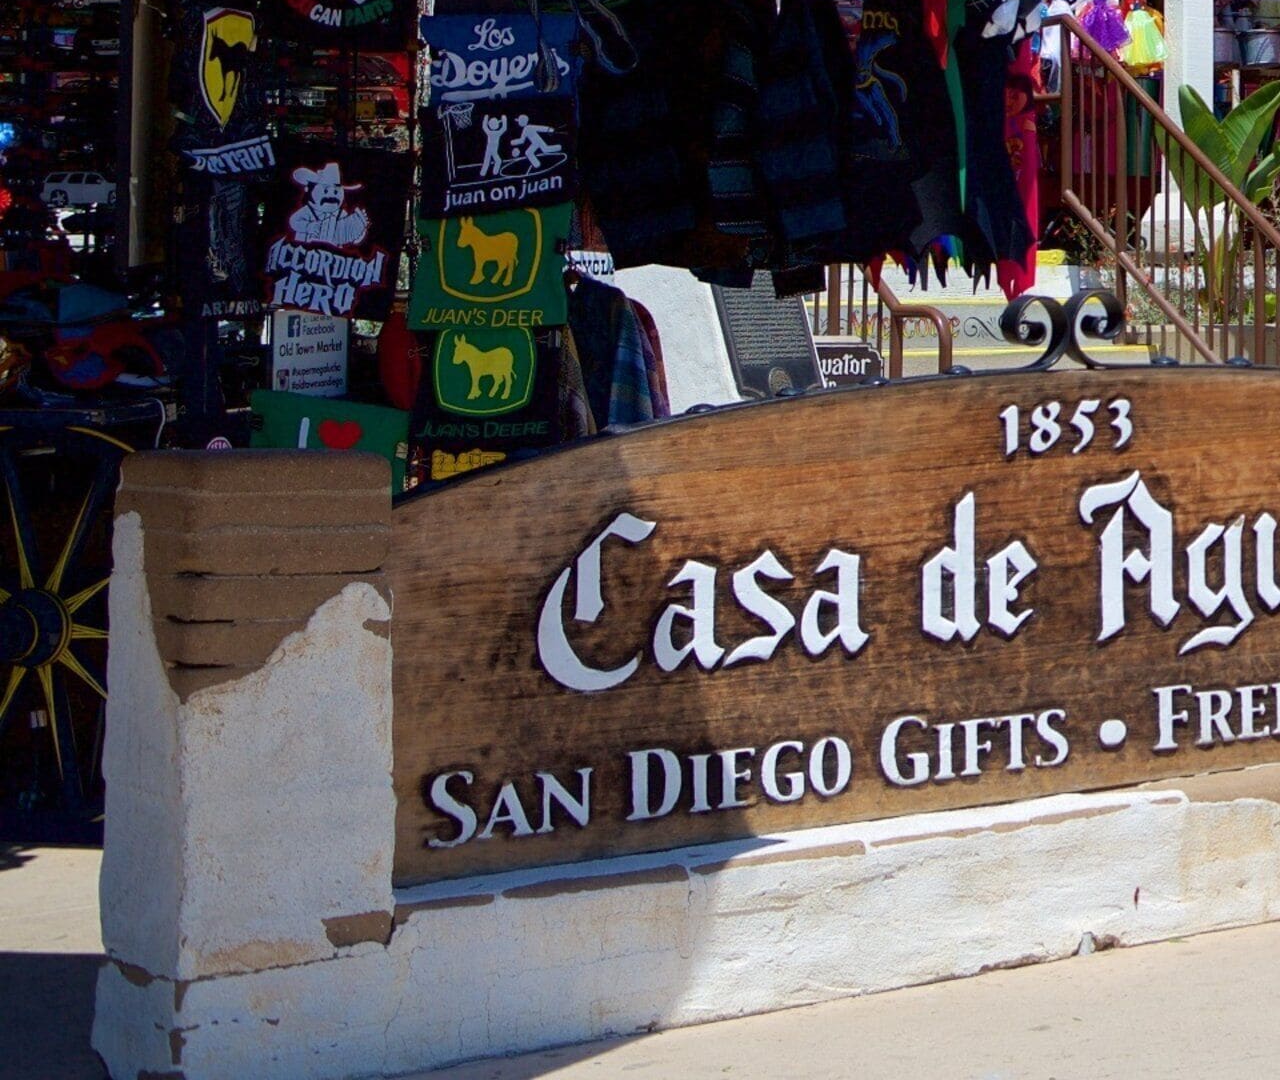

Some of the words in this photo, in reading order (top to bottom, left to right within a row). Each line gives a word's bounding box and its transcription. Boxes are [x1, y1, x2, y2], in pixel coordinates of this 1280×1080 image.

[467, 18, 516, 52] Los
[443, 188, 486, 212] juan
[490, 186, 516, 203] on
[518, 175, 564, 200] juan
[266, 235, 388, 288] ACCORDION
[303, 322, 336, 336] Facebook
[421, 307, 488, 326] JUAN'S
[490, 308, 545, 328] DEER
[279, 342, 294, 357] Old
[295, 343, 315, 356] Town
[316, 338, 343, 353] Market
[415, 420, 482, 439] JUAN'S
[483, 420, 552, 440] DEERE
[998, 398, 1134, 456] 1853
[537, 511, 870, 692] Casa
[921, 491, 1039, 643] de
[426, 767, 594, 849] SAN
[624, 735, 853, 822] DIEGO
[878, 708, 1069, 788] GIFTS
